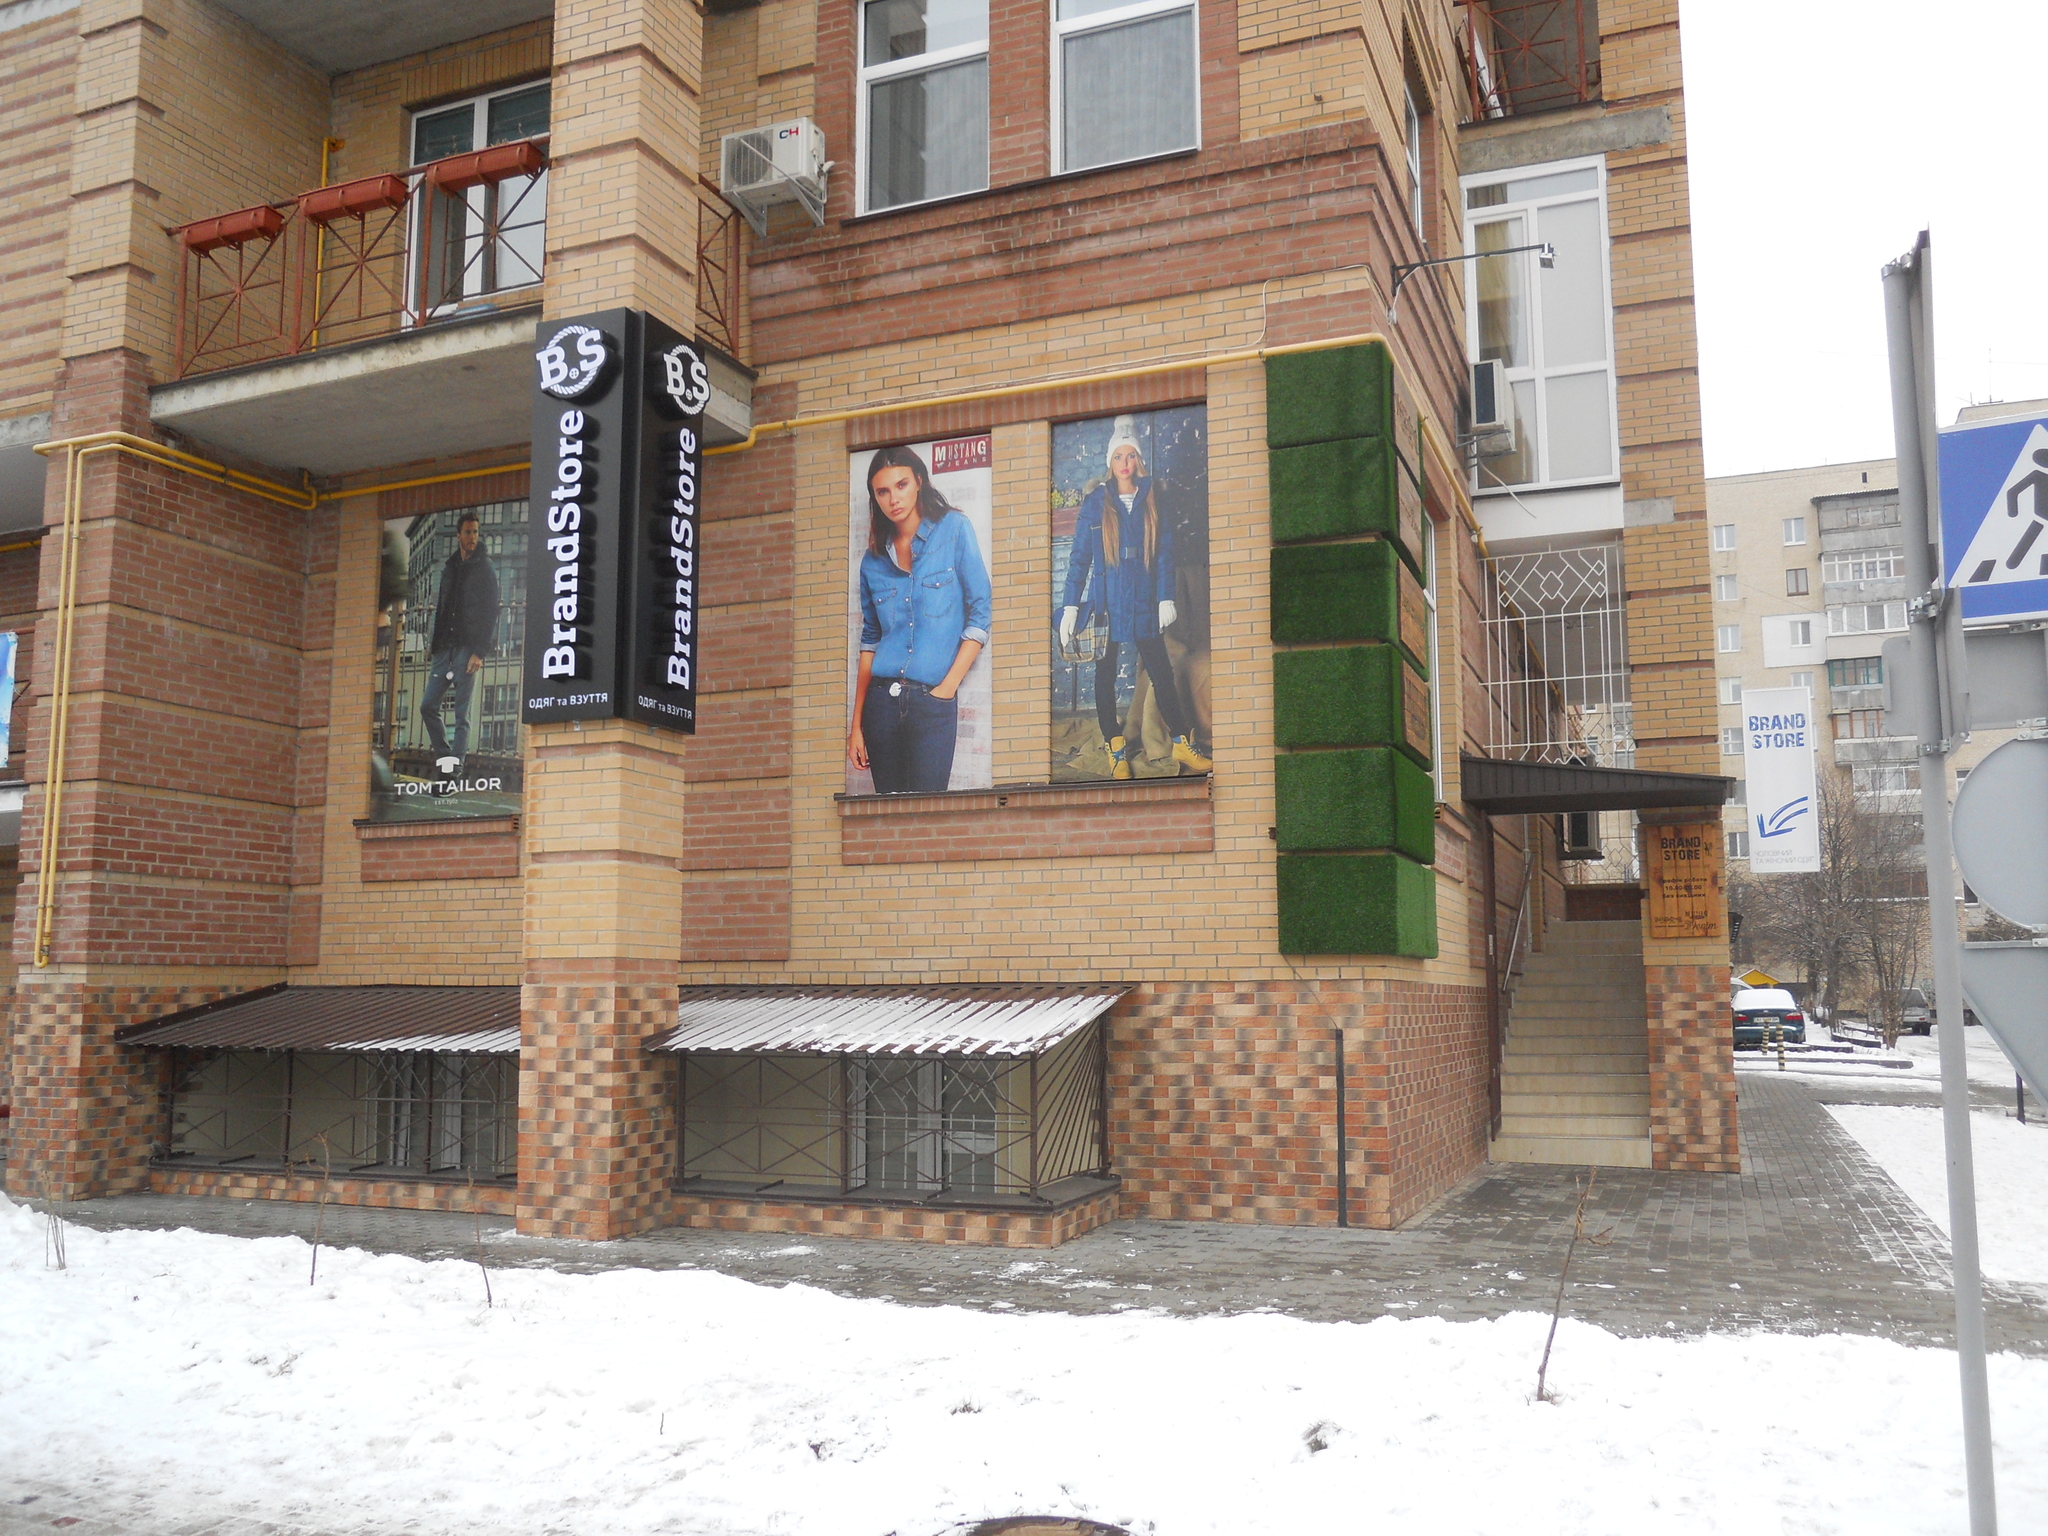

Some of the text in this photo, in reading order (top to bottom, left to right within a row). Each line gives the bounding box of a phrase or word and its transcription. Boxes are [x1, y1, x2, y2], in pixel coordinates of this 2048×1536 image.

[935, 441, 987, 462] MUSTANG
[947, 456, 987, 468] JEANS
[543, 409, 584, 679] BrandStore
[667, 428, 696, 690] BrandStore
[529, 692, 608, 709] ОДЯГ та ВЗУТТЯ
[638, 695, 692, 720] ОДЯГ та ВЗУТТЯ
[1748, 713, 1806, 731] BRAND
[1752, 732, 1805, 749] STORE
[394, 777, 501, 796] TOM TAILOR
[1661, 836, 1701, 849] BRAND
[1663, 849, 1701, 861] STORE
